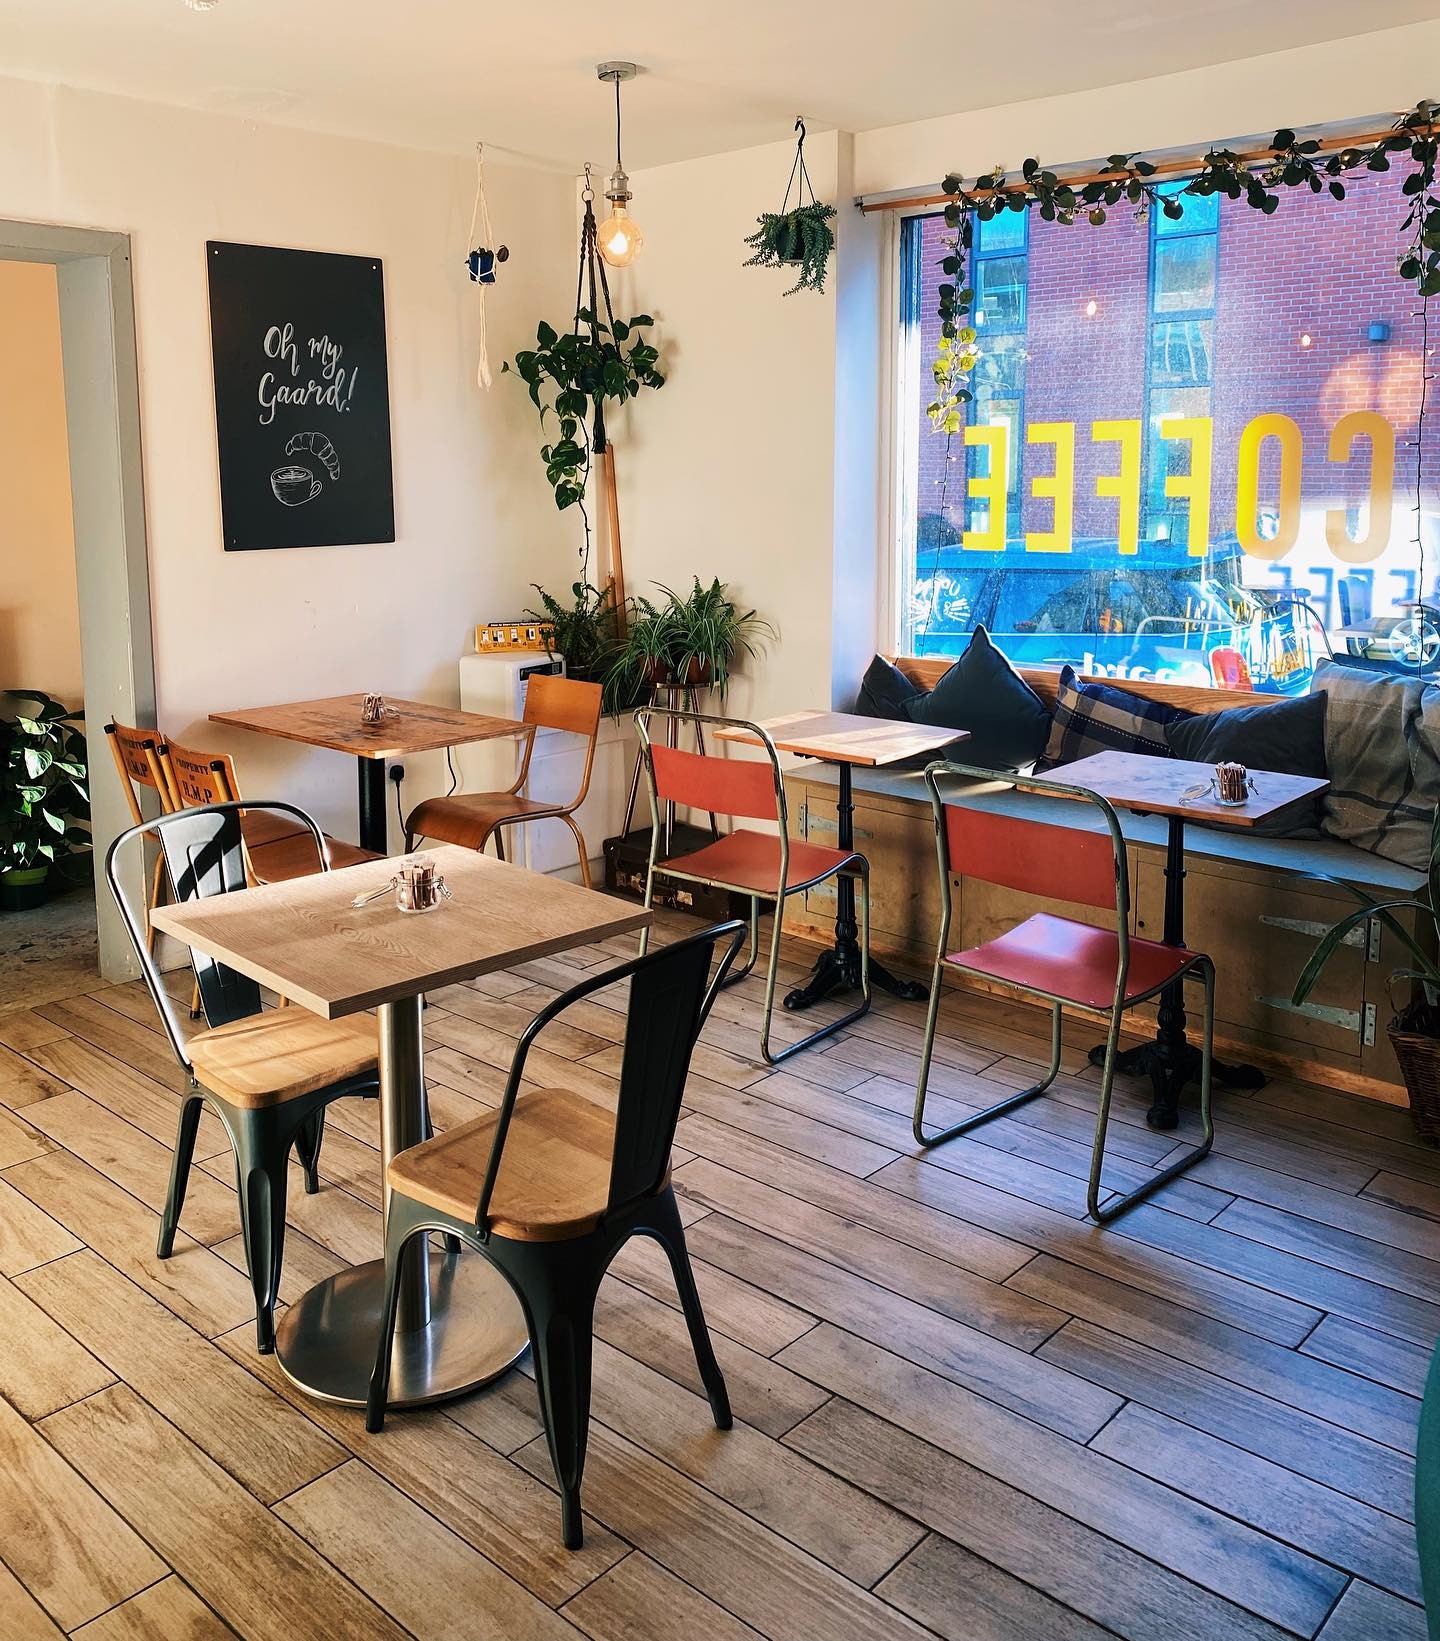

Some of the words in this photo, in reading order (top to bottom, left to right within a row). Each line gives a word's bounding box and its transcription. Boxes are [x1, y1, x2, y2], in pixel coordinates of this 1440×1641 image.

[263, 322, 300, 376] Oh
[258, 367, 358, 425] Gaard!
[175, 757, 209, 775] PROPERTY
